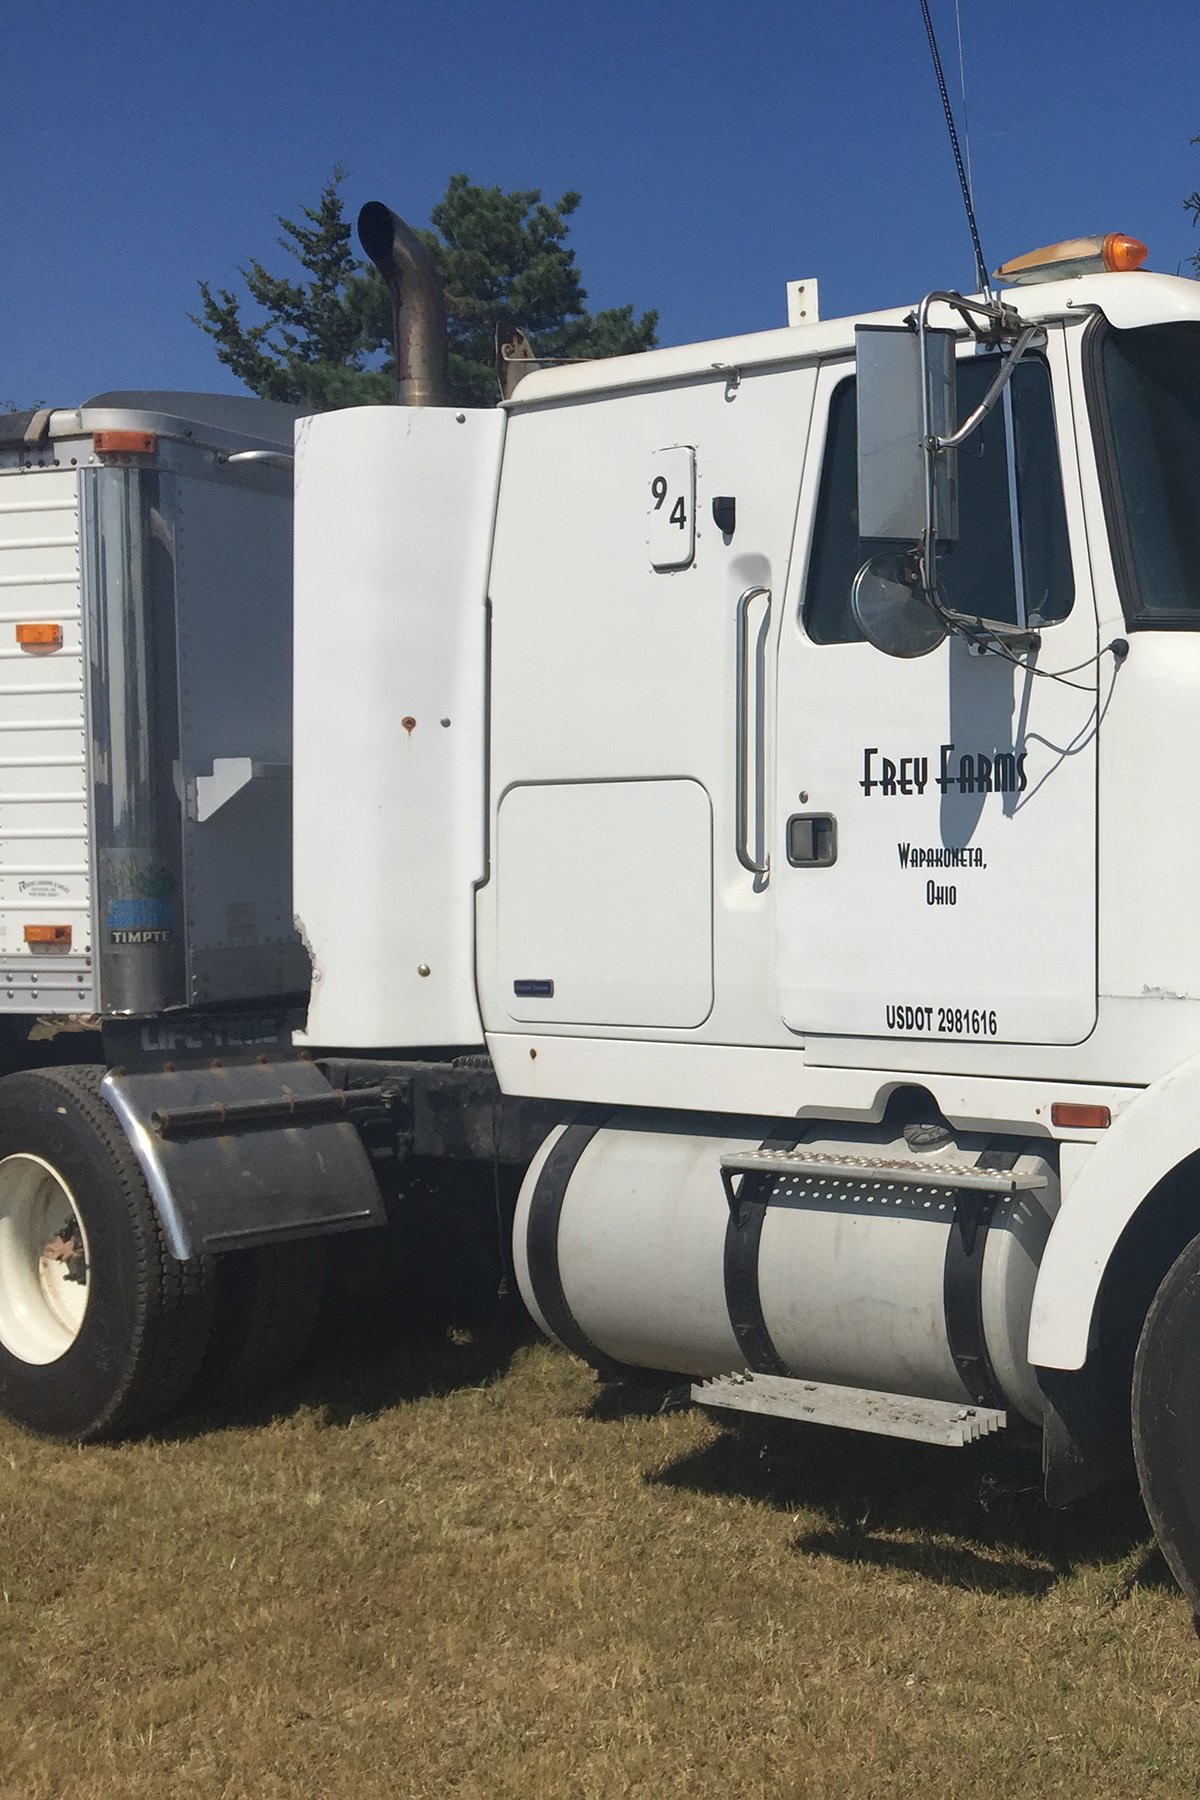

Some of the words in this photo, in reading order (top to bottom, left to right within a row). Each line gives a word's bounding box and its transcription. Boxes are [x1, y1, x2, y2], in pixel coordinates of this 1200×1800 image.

[651, 475, 687, 530] 94
[859, 747, 928, 796] FREY
[935, 744, 1028, 794] FARMS
[897, 842, 987, 869] WAPAKONETA,
[926, 879, 957, 905] OHIO
[886, 1004, 933, 1031] USDOT
[937, 1007, 997, 1036] 2981616
